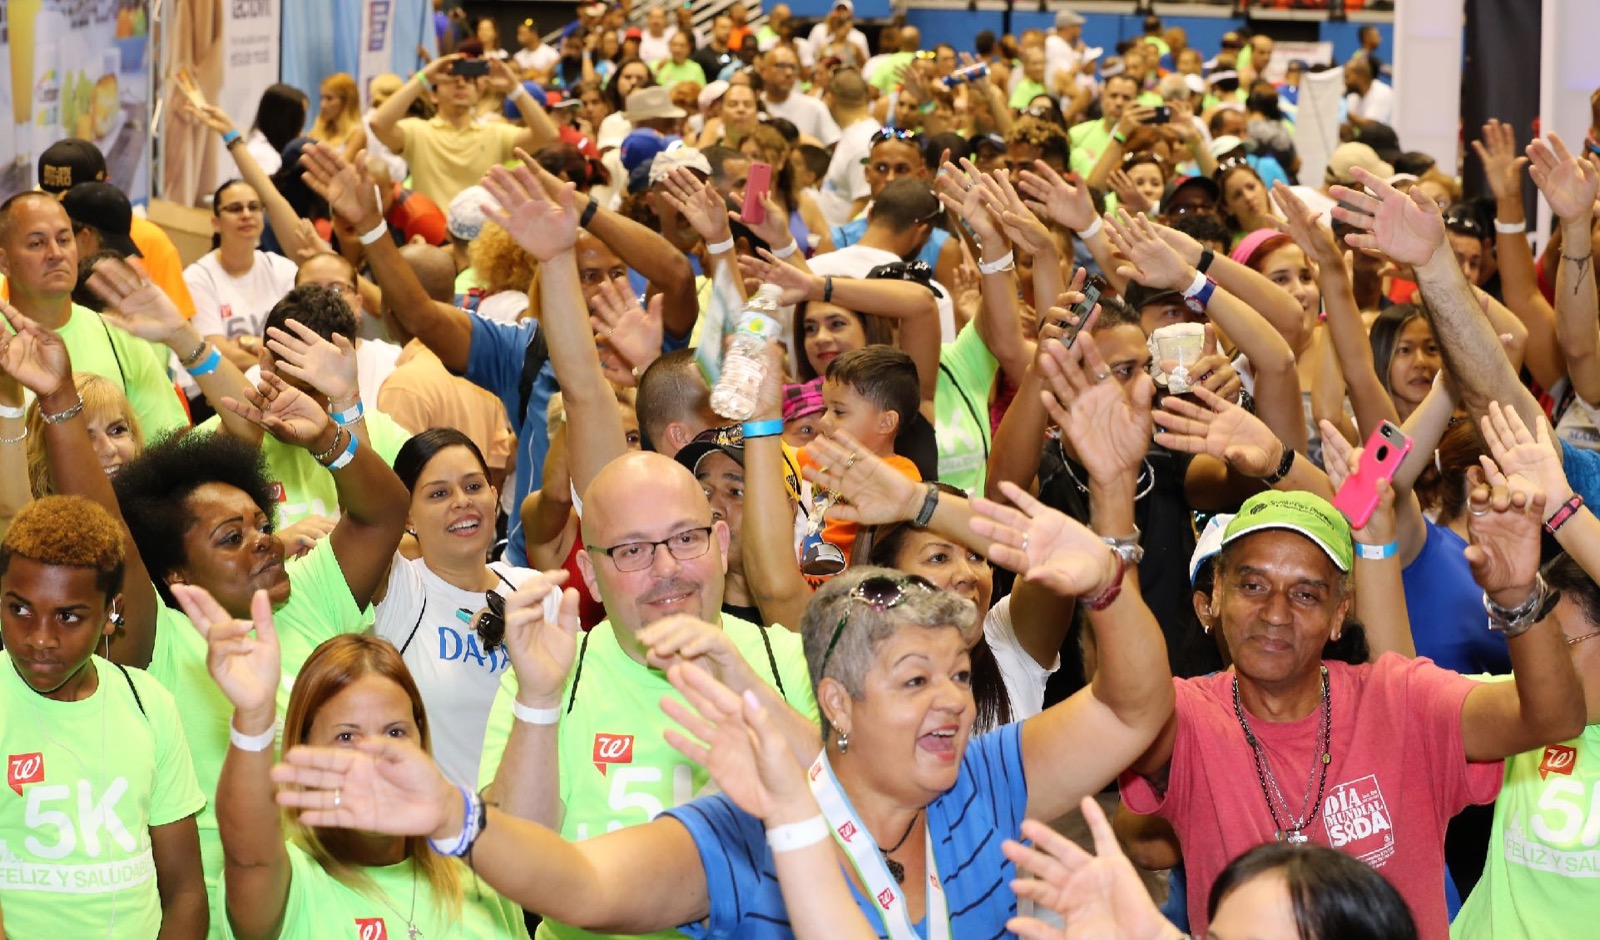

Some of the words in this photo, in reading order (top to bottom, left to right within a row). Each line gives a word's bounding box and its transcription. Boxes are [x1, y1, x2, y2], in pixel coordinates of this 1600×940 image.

[1324, 786, 1364, 816] DÍA
[1325, 800, 1384, 827] MUNDIAL
[24, 776, 137, 860] 5K
[1506, 840, 1548, 865] FELIZ
[1552, 854, 1562, 869] Y
[56, 870, 70, 888] Y
